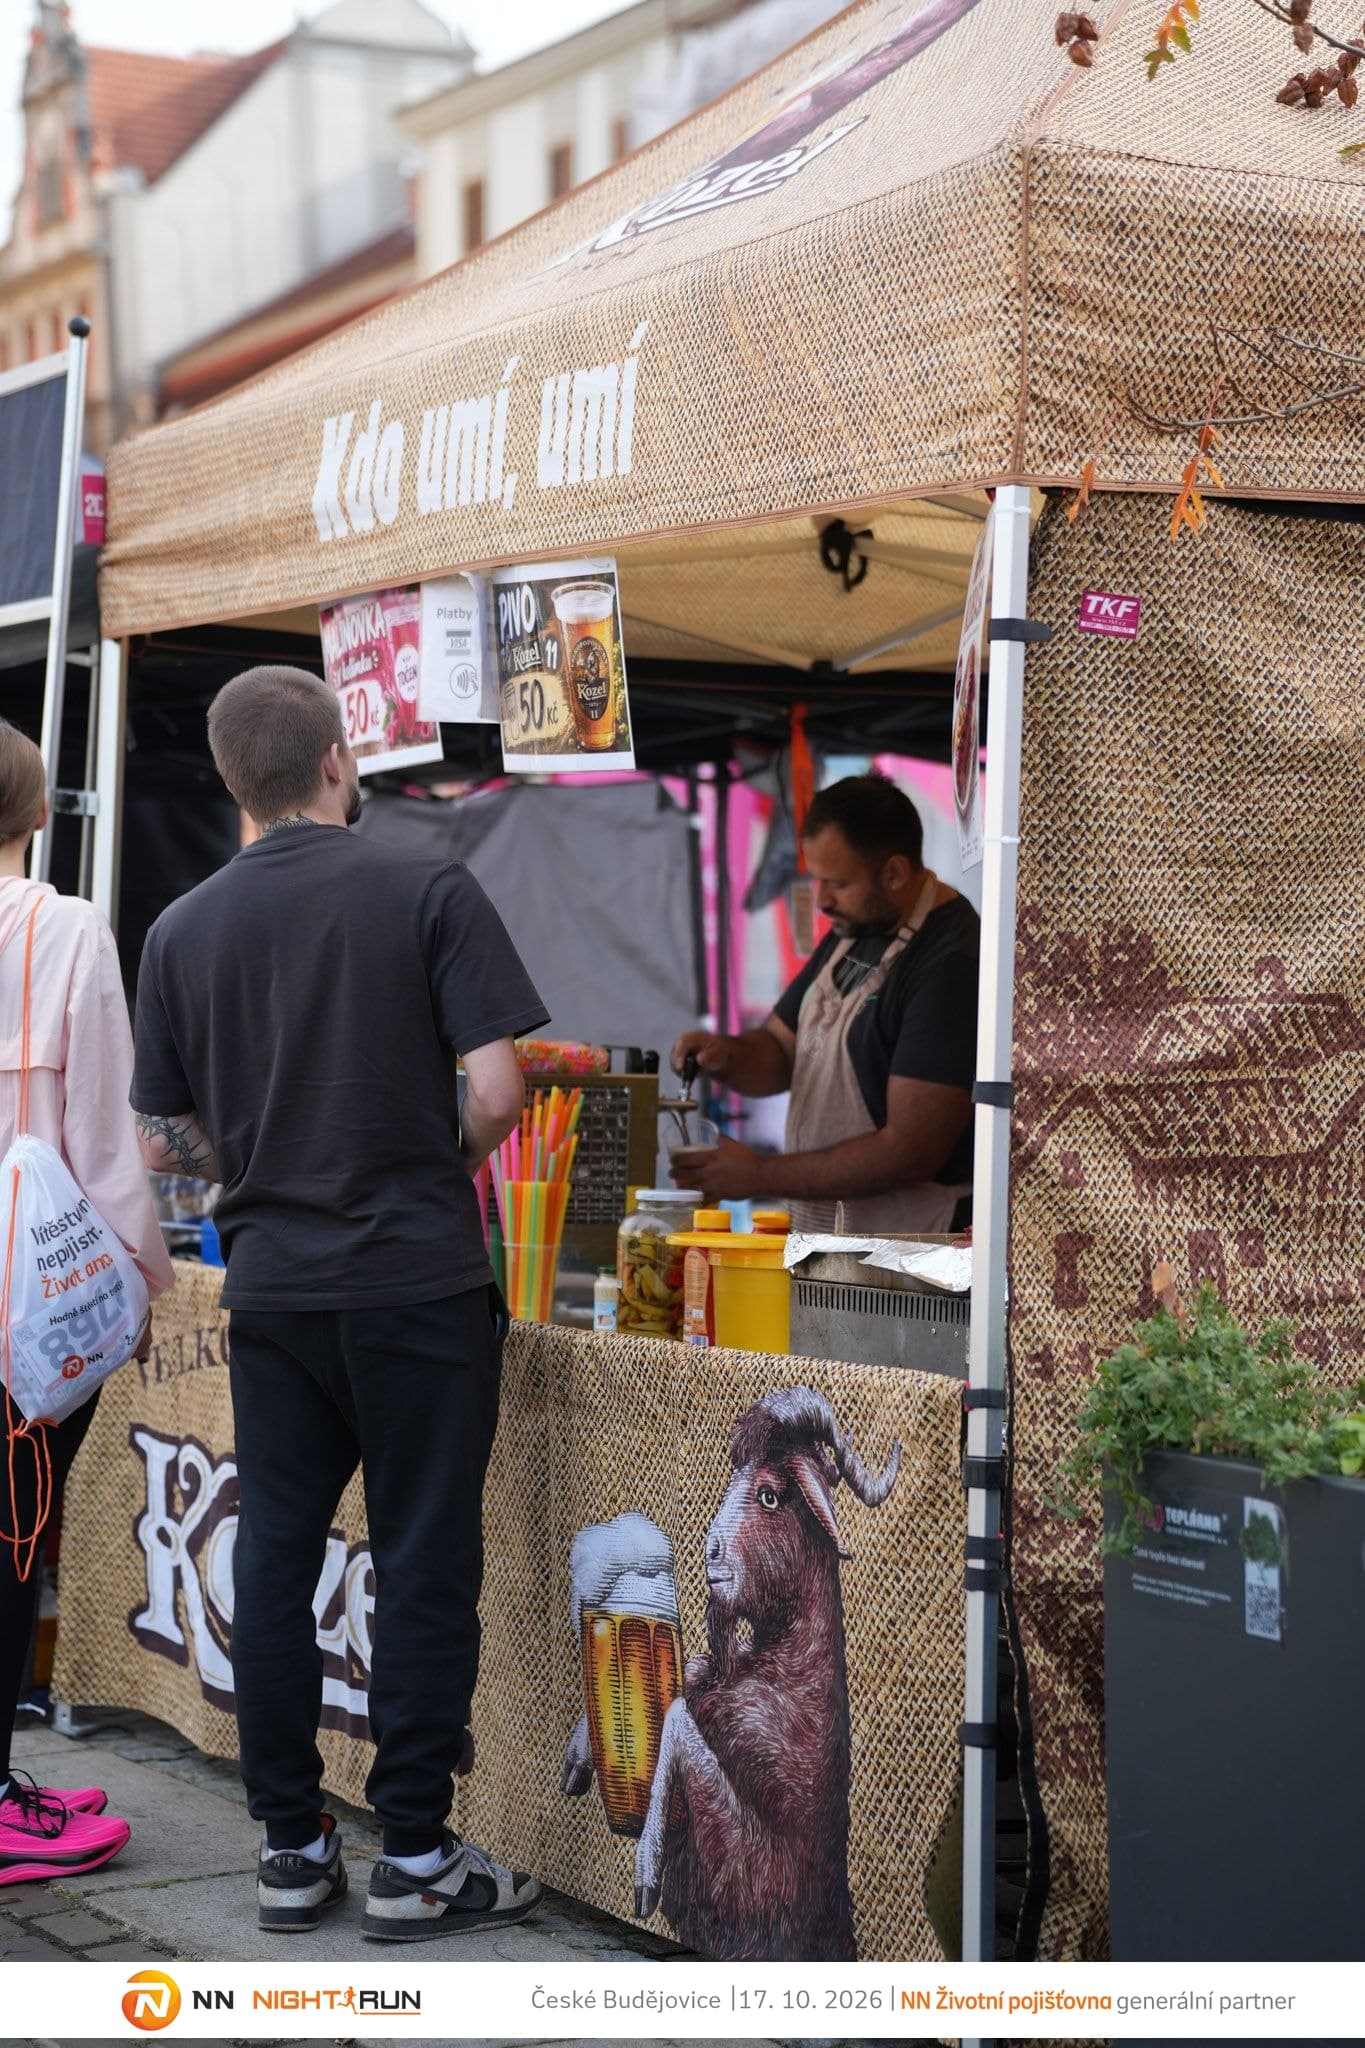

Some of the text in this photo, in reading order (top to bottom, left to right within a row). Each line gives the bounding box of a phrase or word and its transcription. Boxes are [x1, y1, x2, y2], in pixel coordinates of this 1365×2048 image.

[312, 321, 650, 542] Kdo umí, umí
[436, 608, 472, 621] Platby
[498, 584, 536, 644] PIVO
[1086, 595, 1138, 618] TKF
[450, 638, 467, 649] VISA
[512, 641, 542, 672] Kozel
[545, 639, 558, 670] 11
[577, 682, 607, 701] Kozel
[346, 688, 369, 740] 50
[519, 679, 544, 735] 50
[49, 1307, 79, 1326] Hodně
[87, 1351, 104, 1365] NN
[273, 1856, 304, 1868] NIKE
